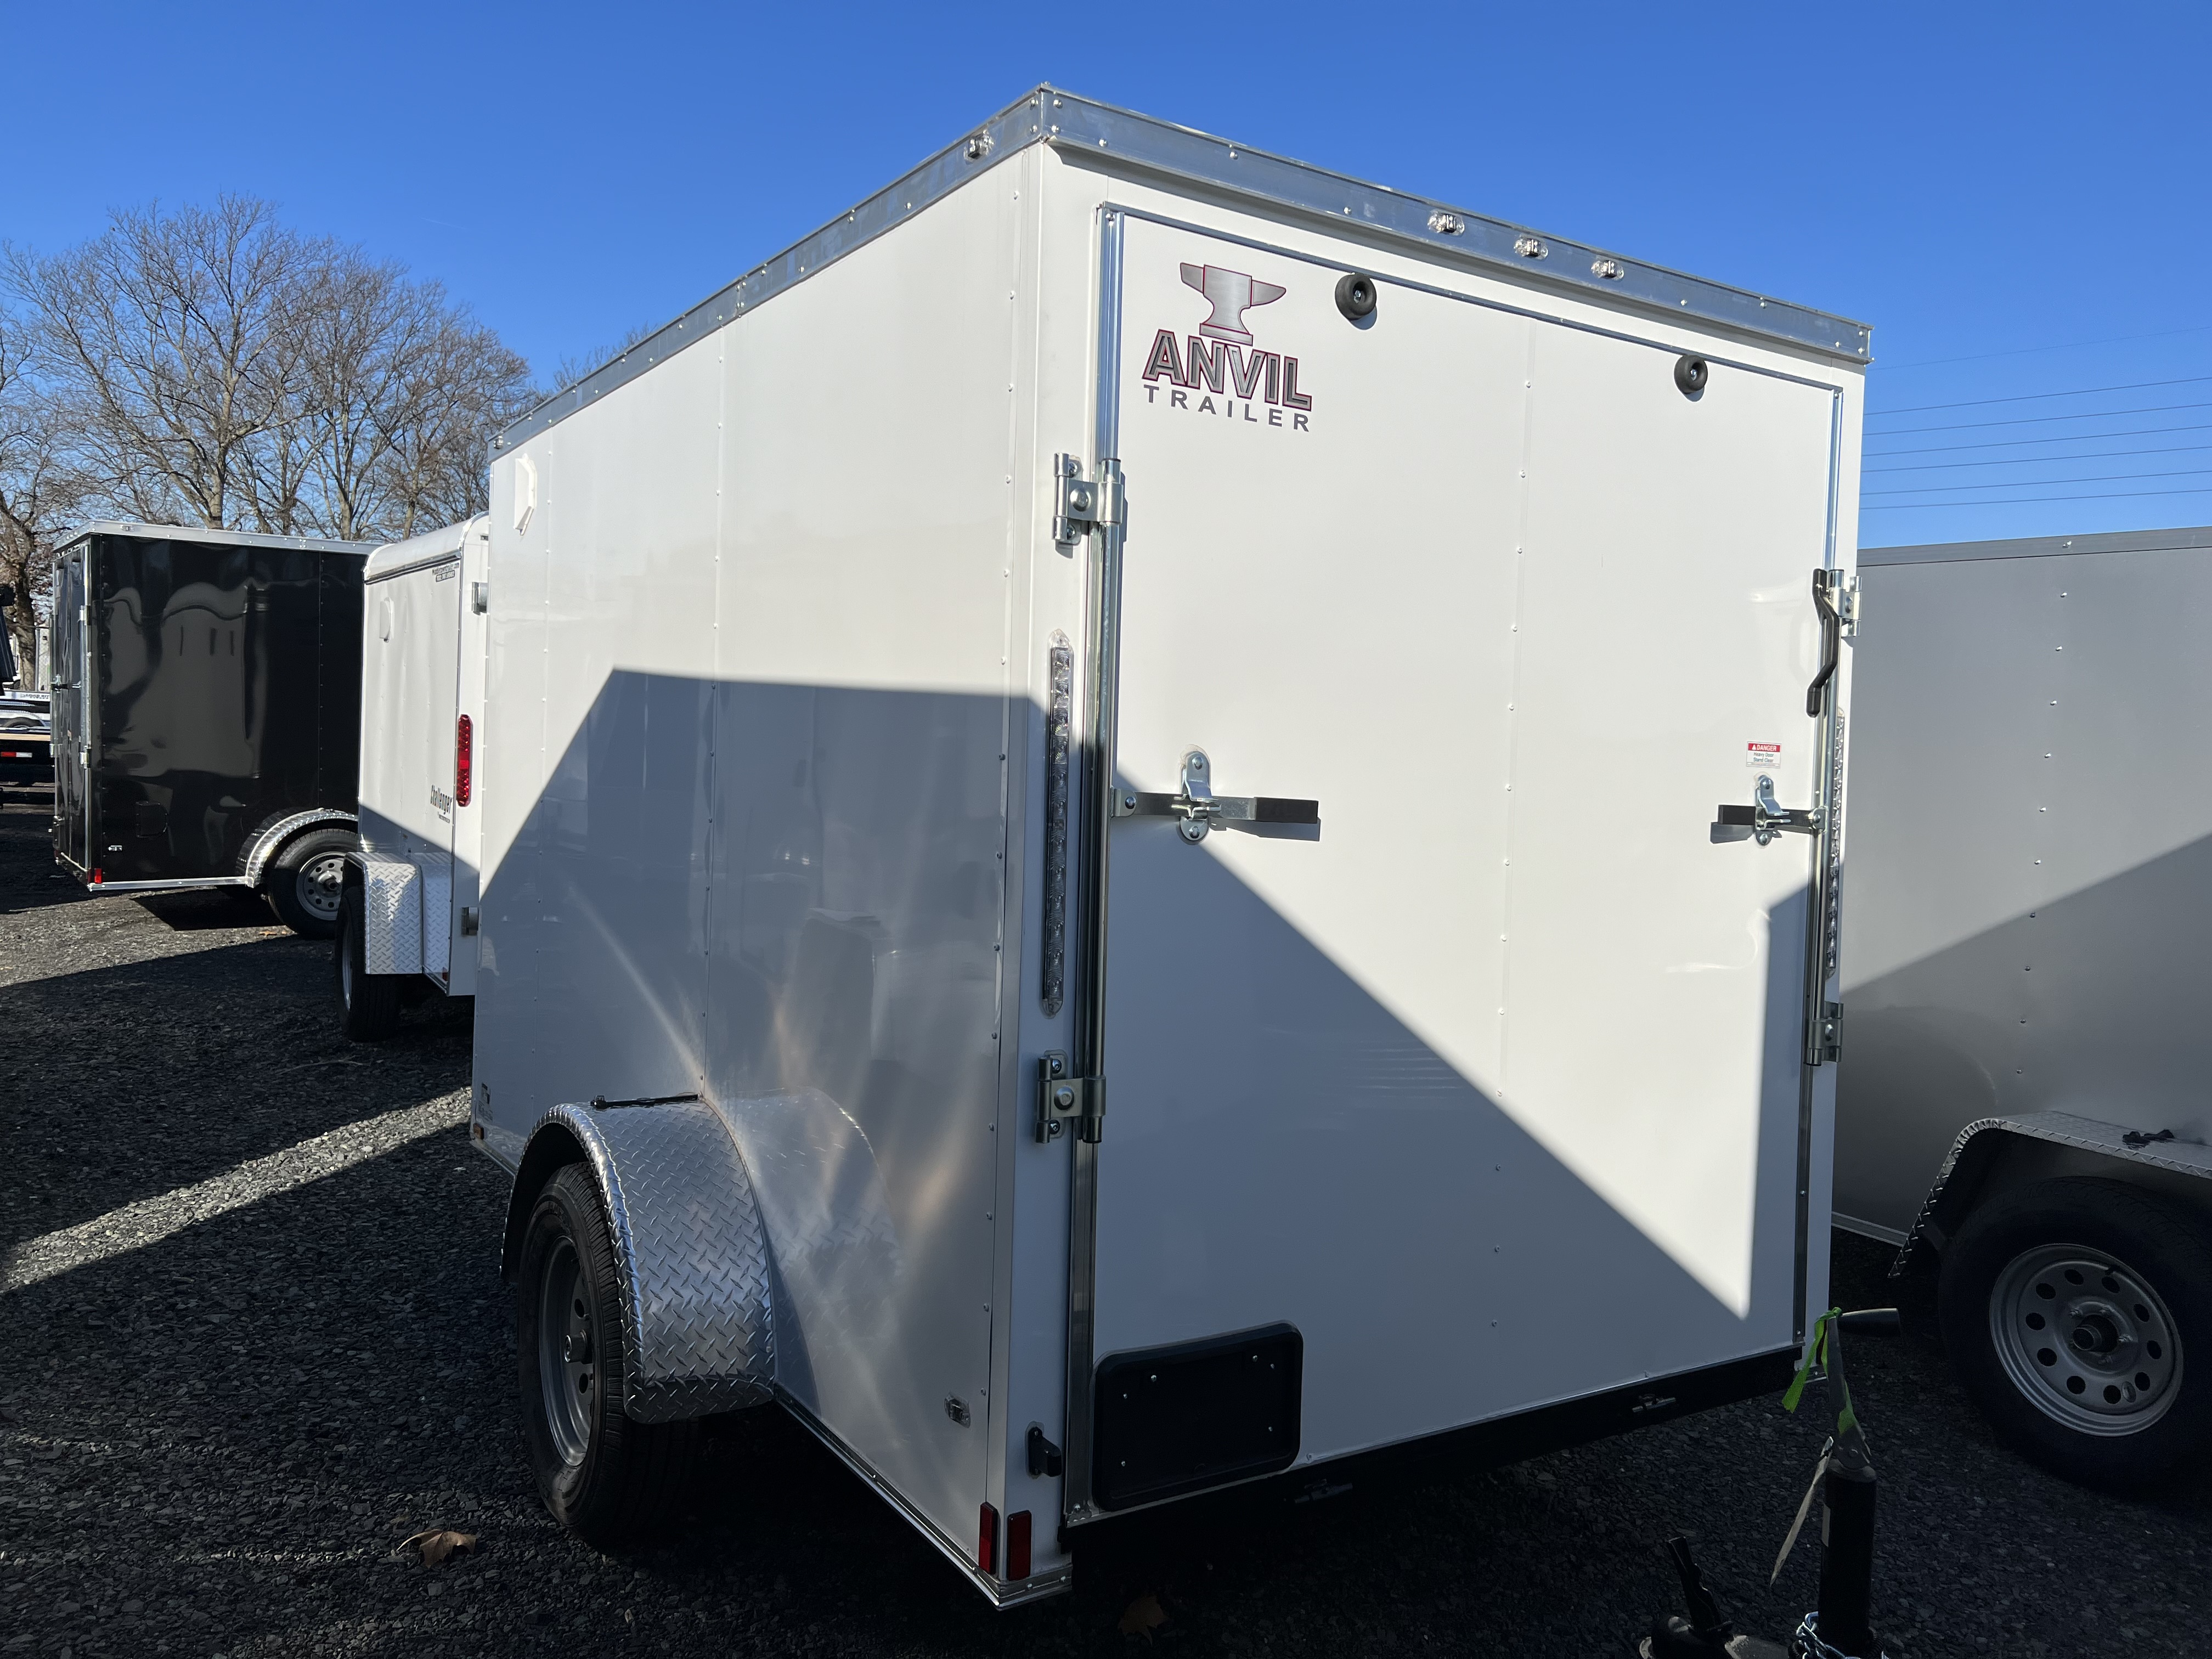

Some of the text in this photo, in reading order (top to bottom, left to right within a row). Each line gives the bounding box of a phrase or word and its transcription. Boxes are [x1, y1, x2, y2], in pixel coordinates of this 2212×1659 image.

[1142, 329, 1312, 411] ANVIL
[1144, 384, 1309, 432] TRAILER
[430, 785, 452, 815] Challenger
